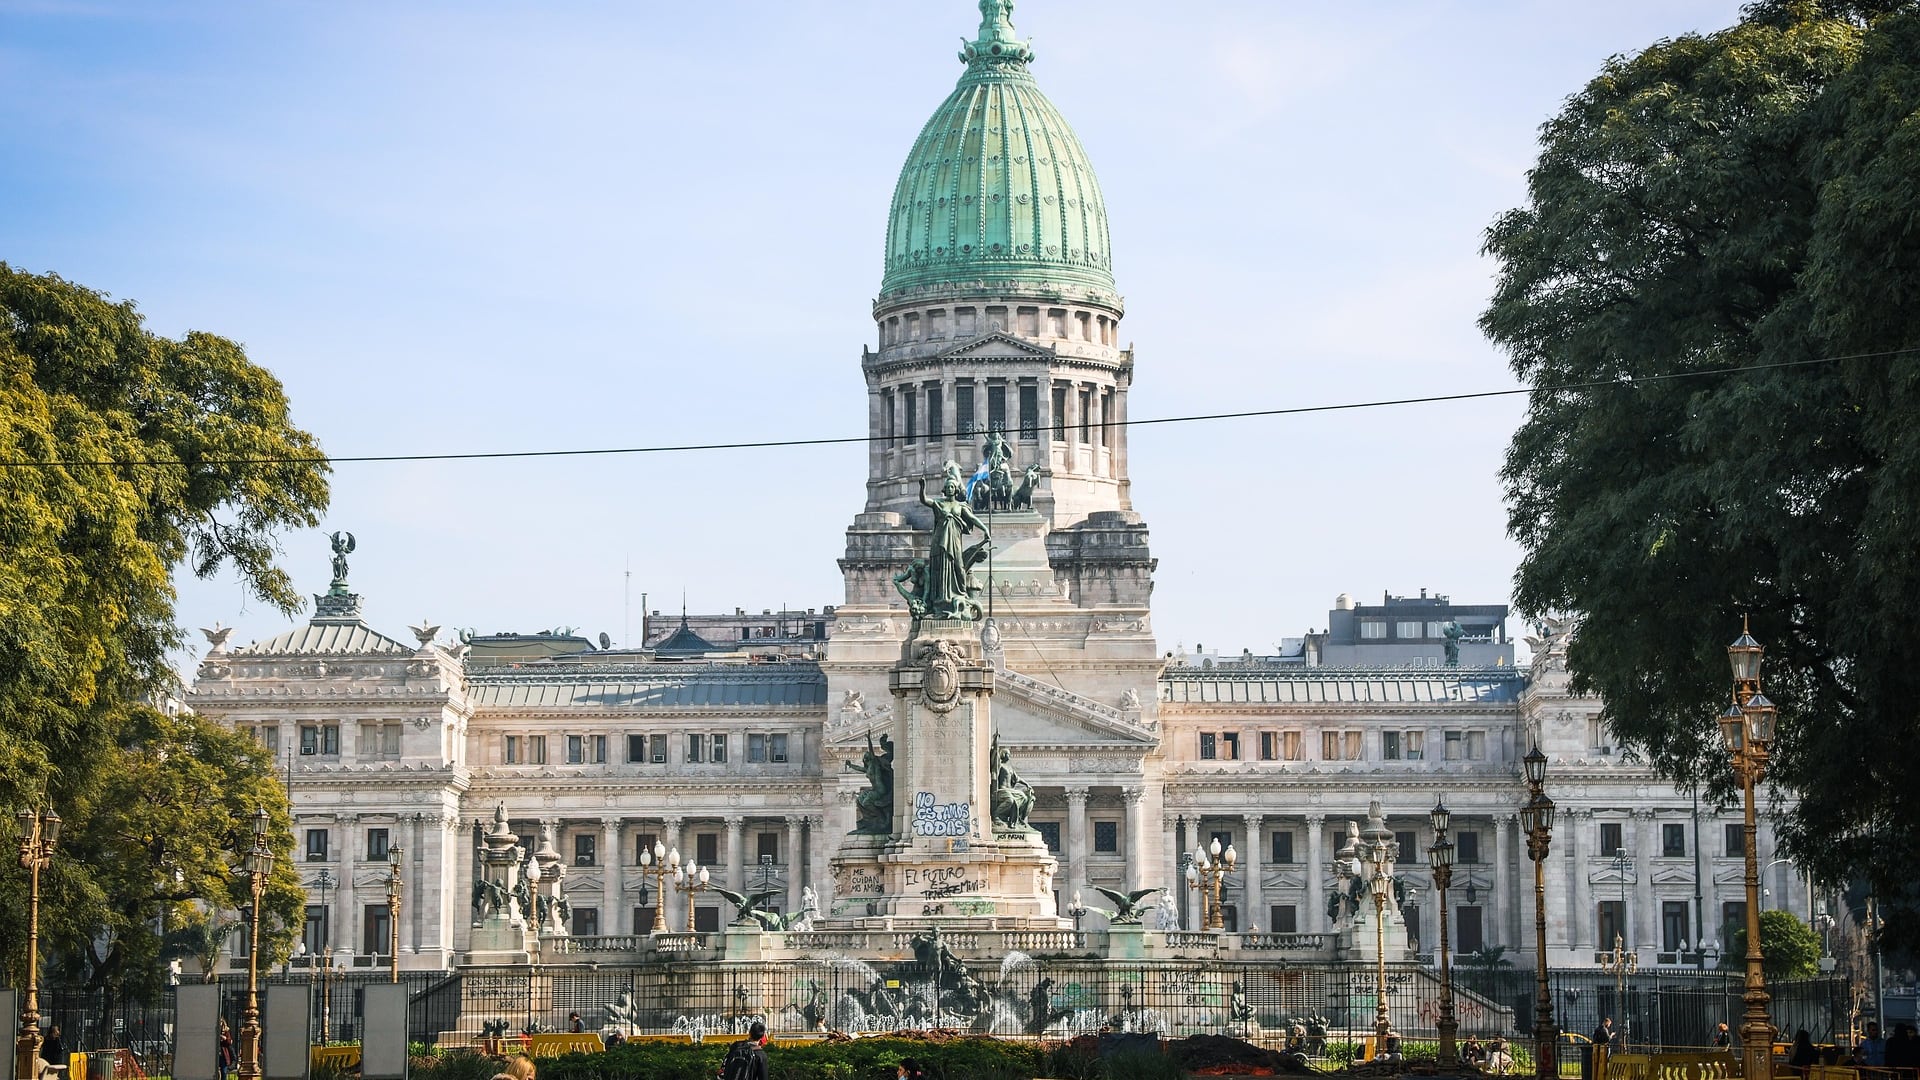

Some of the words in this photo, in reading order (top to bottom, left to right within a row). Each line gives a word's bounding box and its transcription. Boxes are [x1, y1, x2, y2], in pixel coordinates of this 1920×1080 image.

[914, 730, 967, 738] ARGENTINA
[916, 791, 935, 808] NO
[915, 803, 969, 820] ESTAMOS
[912, 819, 966, 836] TODAS
[905, 869, 919, 886] EL
[922, 866, 965, 882] FUTURO
[931, 880, 950, 890] ES
